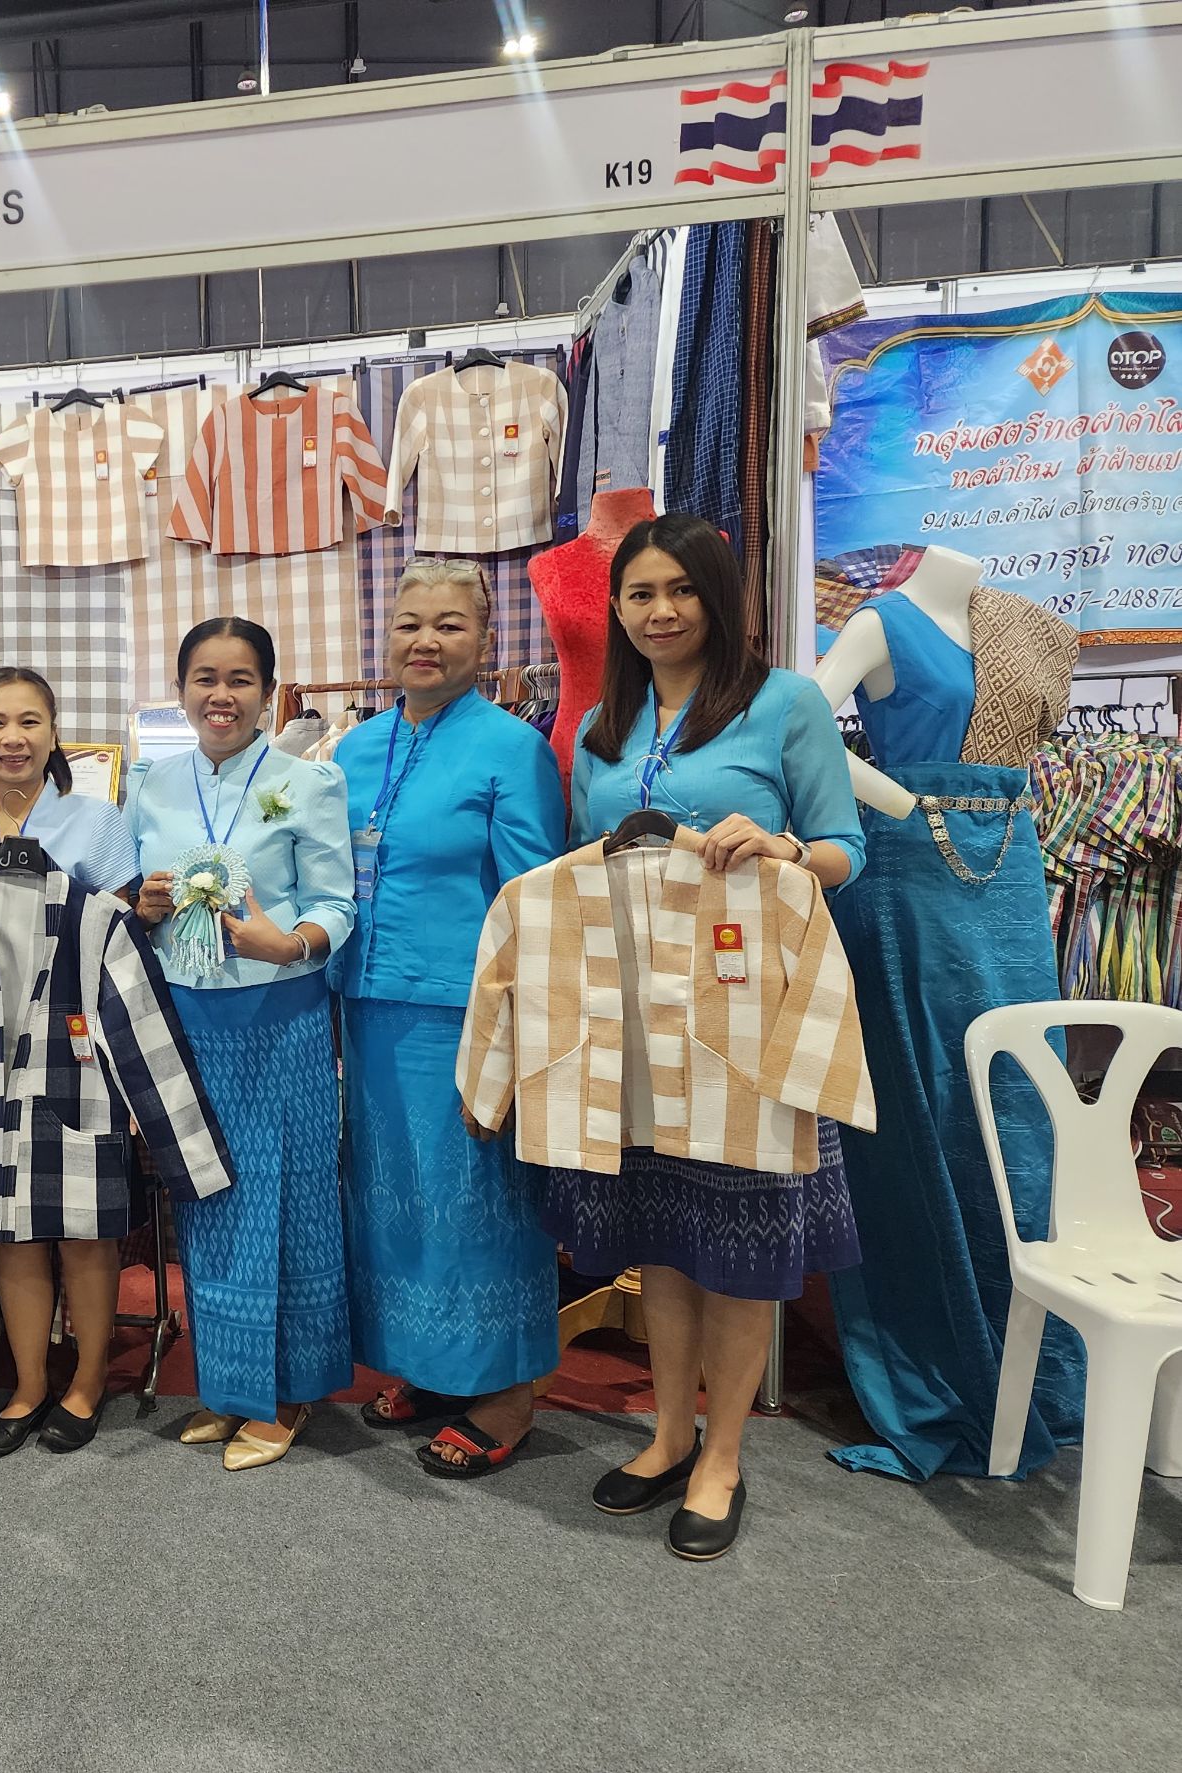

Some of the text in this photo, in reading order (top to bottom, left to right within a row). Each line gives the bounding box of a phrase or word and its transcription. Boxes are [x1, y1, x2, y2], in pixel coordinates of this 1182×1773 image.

[605, 159, 652, 188] K19
[1111, 349, 1162, 364] OTOP
[952, 454, 1061, 489] ทอผ้าไหม
[921, 512, 947, 531] 94
[980, 535, 1115, 579] างจารุณี
